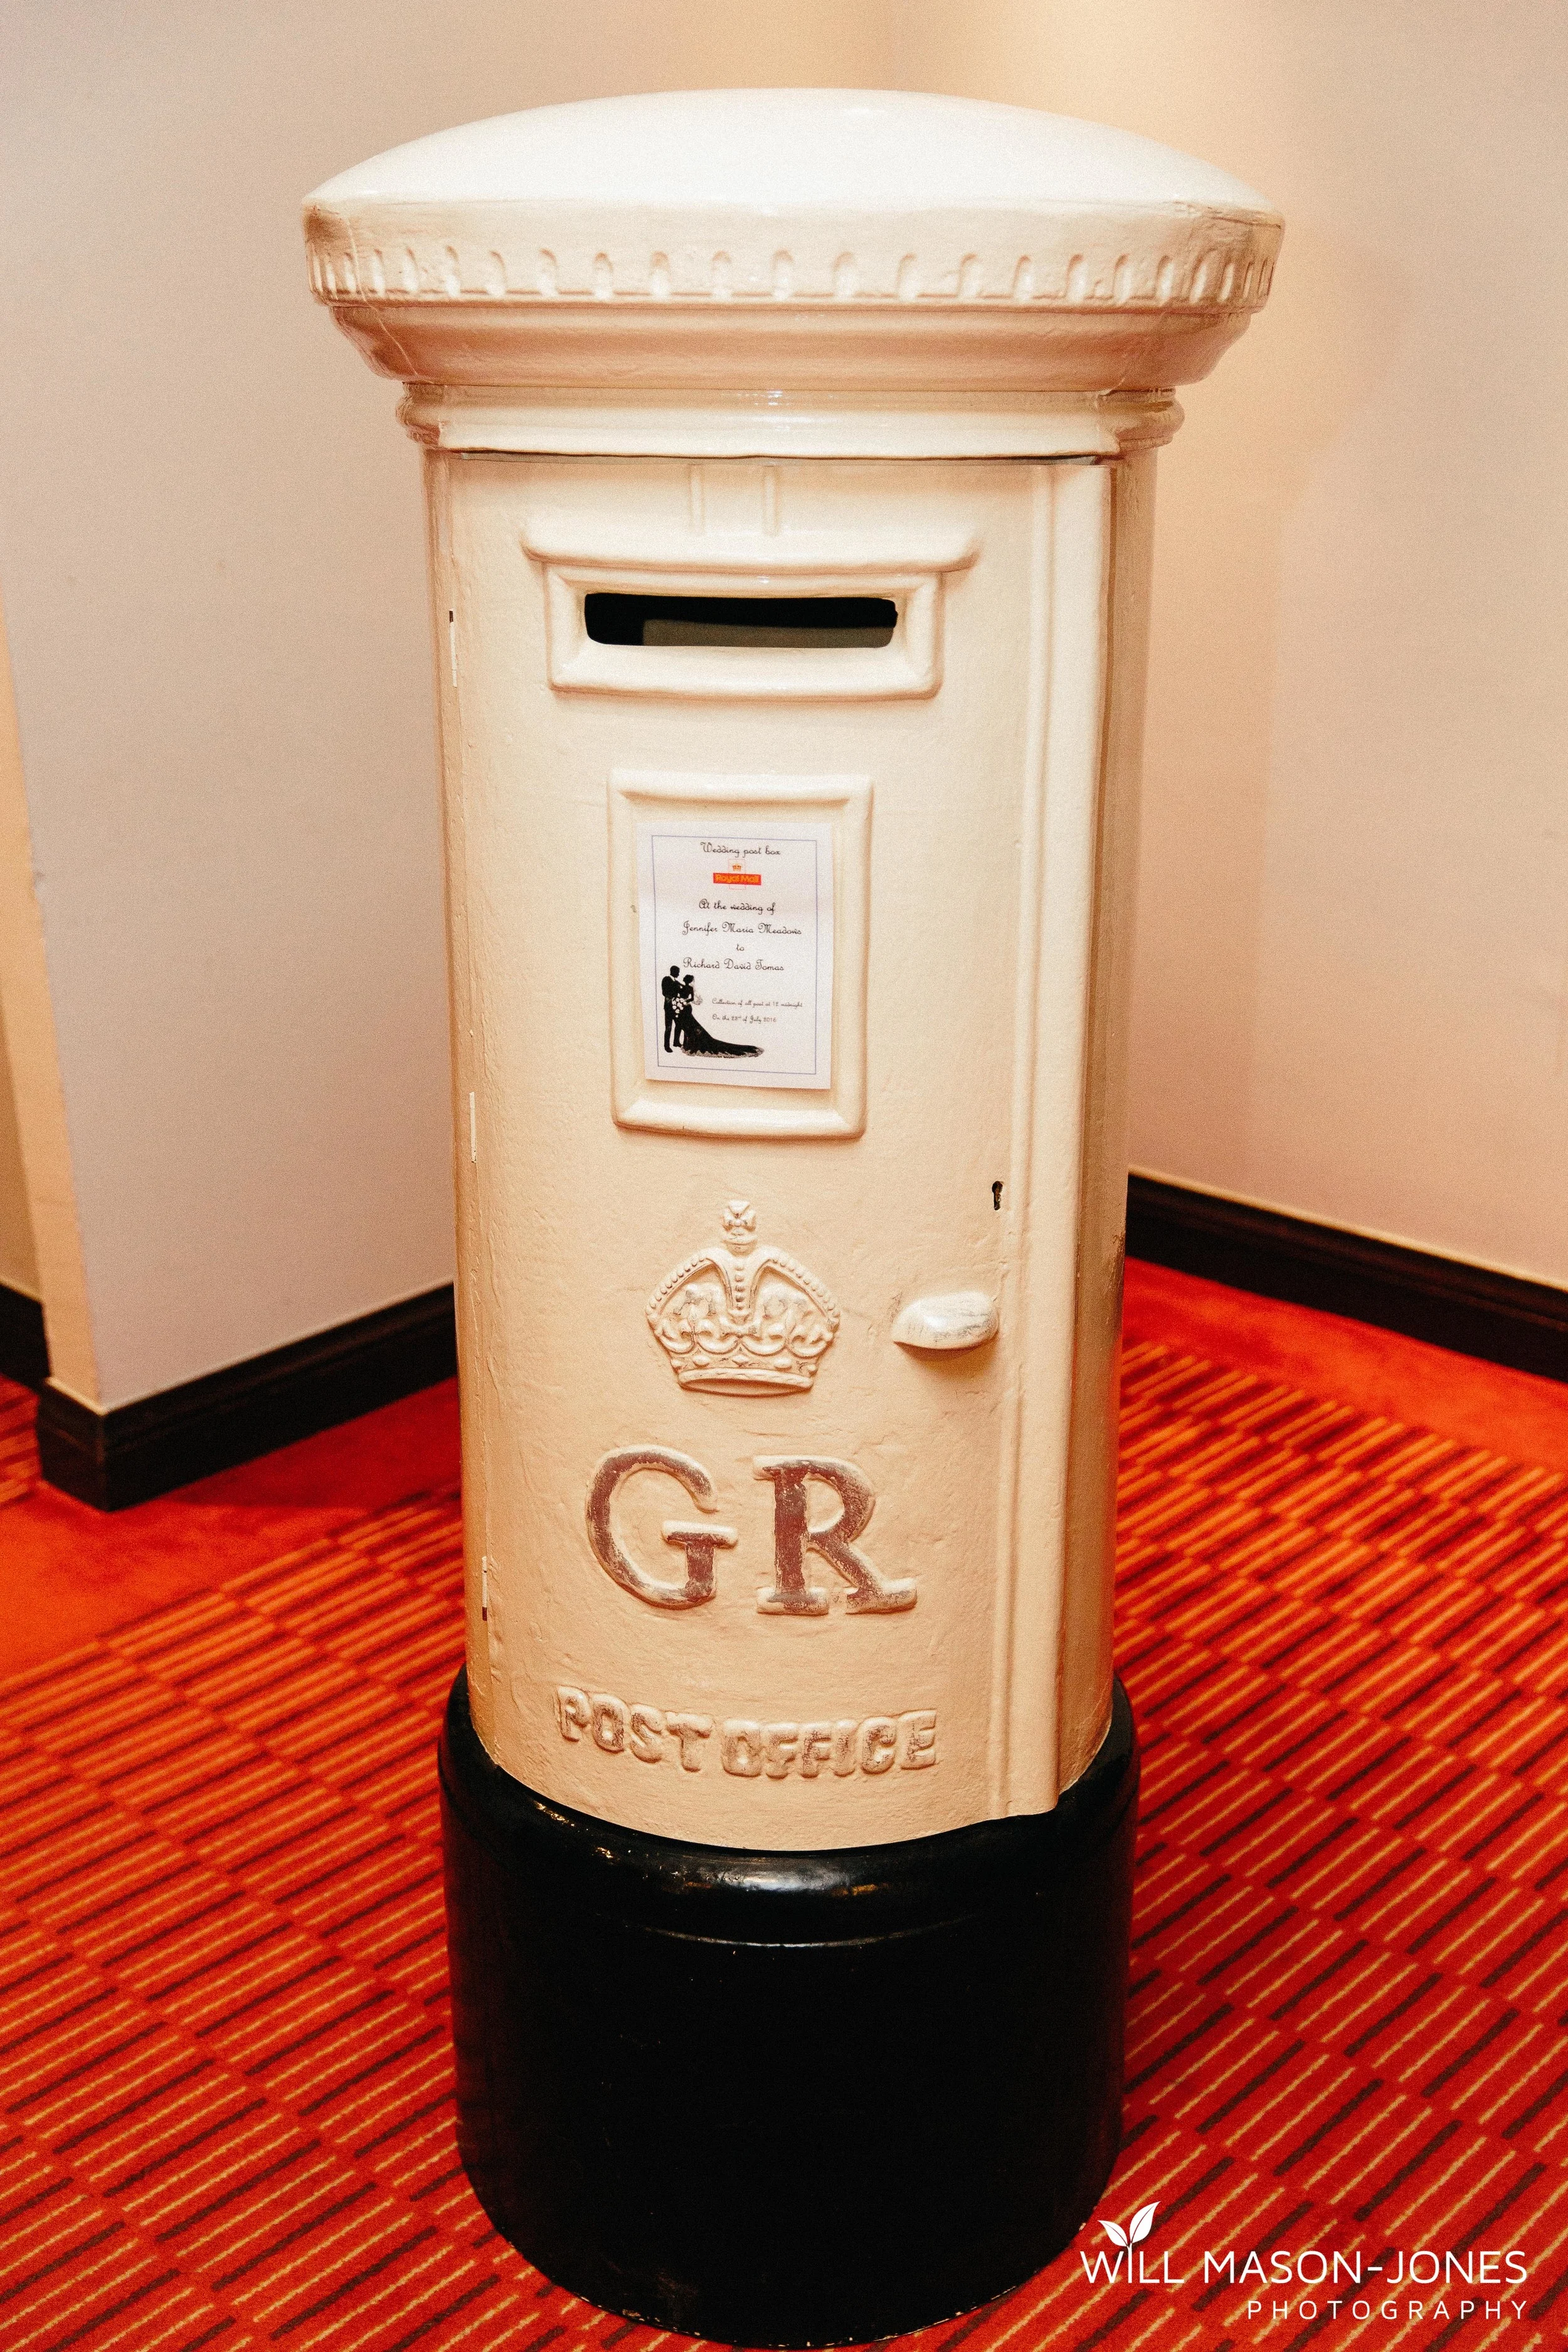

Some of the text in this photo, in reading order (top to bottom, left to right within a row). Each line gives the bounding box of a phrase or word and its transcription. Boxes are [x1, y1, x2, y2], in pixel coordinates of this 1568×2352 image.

[700, 842, 781, 858] Wedding post box
[699, 898, 776, 915] At the wedding of
[682, 920, 802, 936] Jennifer Maria Meadows
[736, 943, 745, 951] to
[683, 956, 720, 969] Richard
[724, 958, 752, 970] David
[750, 1015, 762, 1024] July
[555, 1685, 937, 1780] POST OFFICE
